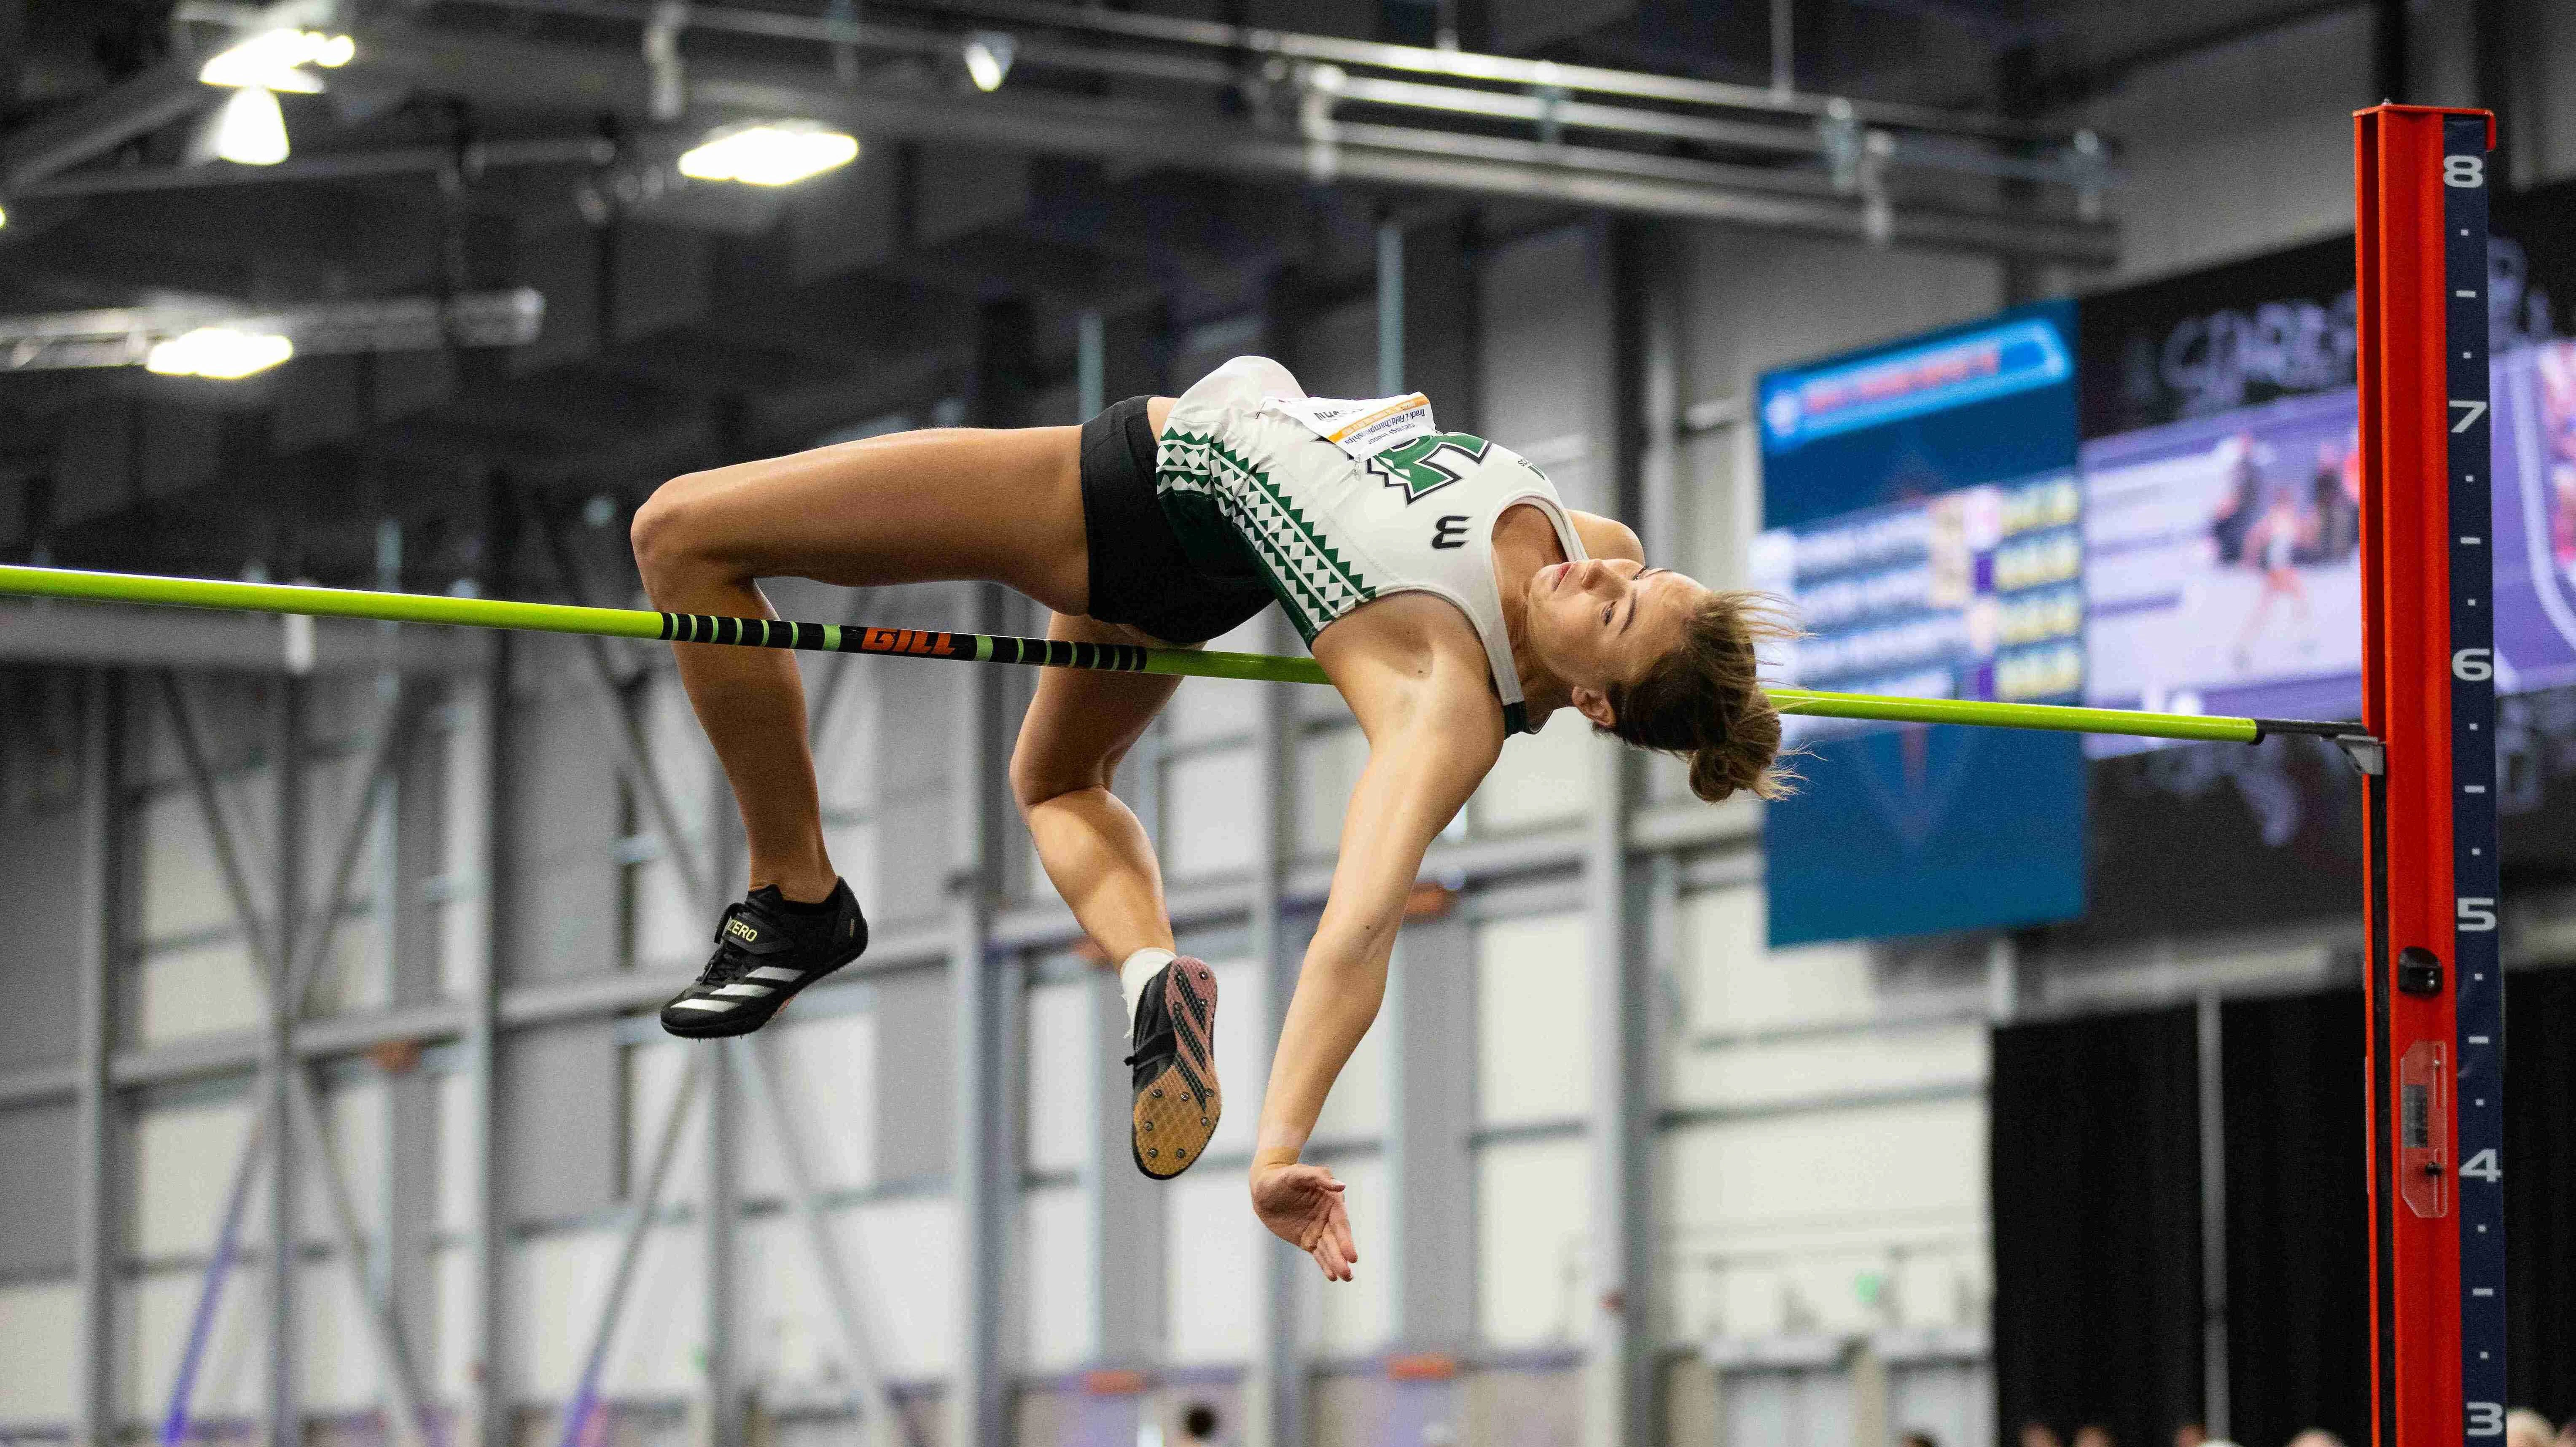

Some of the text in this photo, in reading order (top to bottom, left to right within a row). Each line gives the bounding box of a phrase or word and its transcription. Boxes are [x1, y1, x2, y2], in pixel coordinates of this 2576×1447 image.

[2444, 155, 2483, 188] 8
[1391, 414, 1405, 425] Field
[1409, 408, 1425, 420] Track
[2449, 401, 2487, 433] 7
[861, 627, 956, 655] GILL
[2452, 648, 2492, 681] 6
[2458, 898, 2496, 931] 5
[2459, 1149, 2501, 1182] 4
[2468, 1402, 2503, 1436] 3
